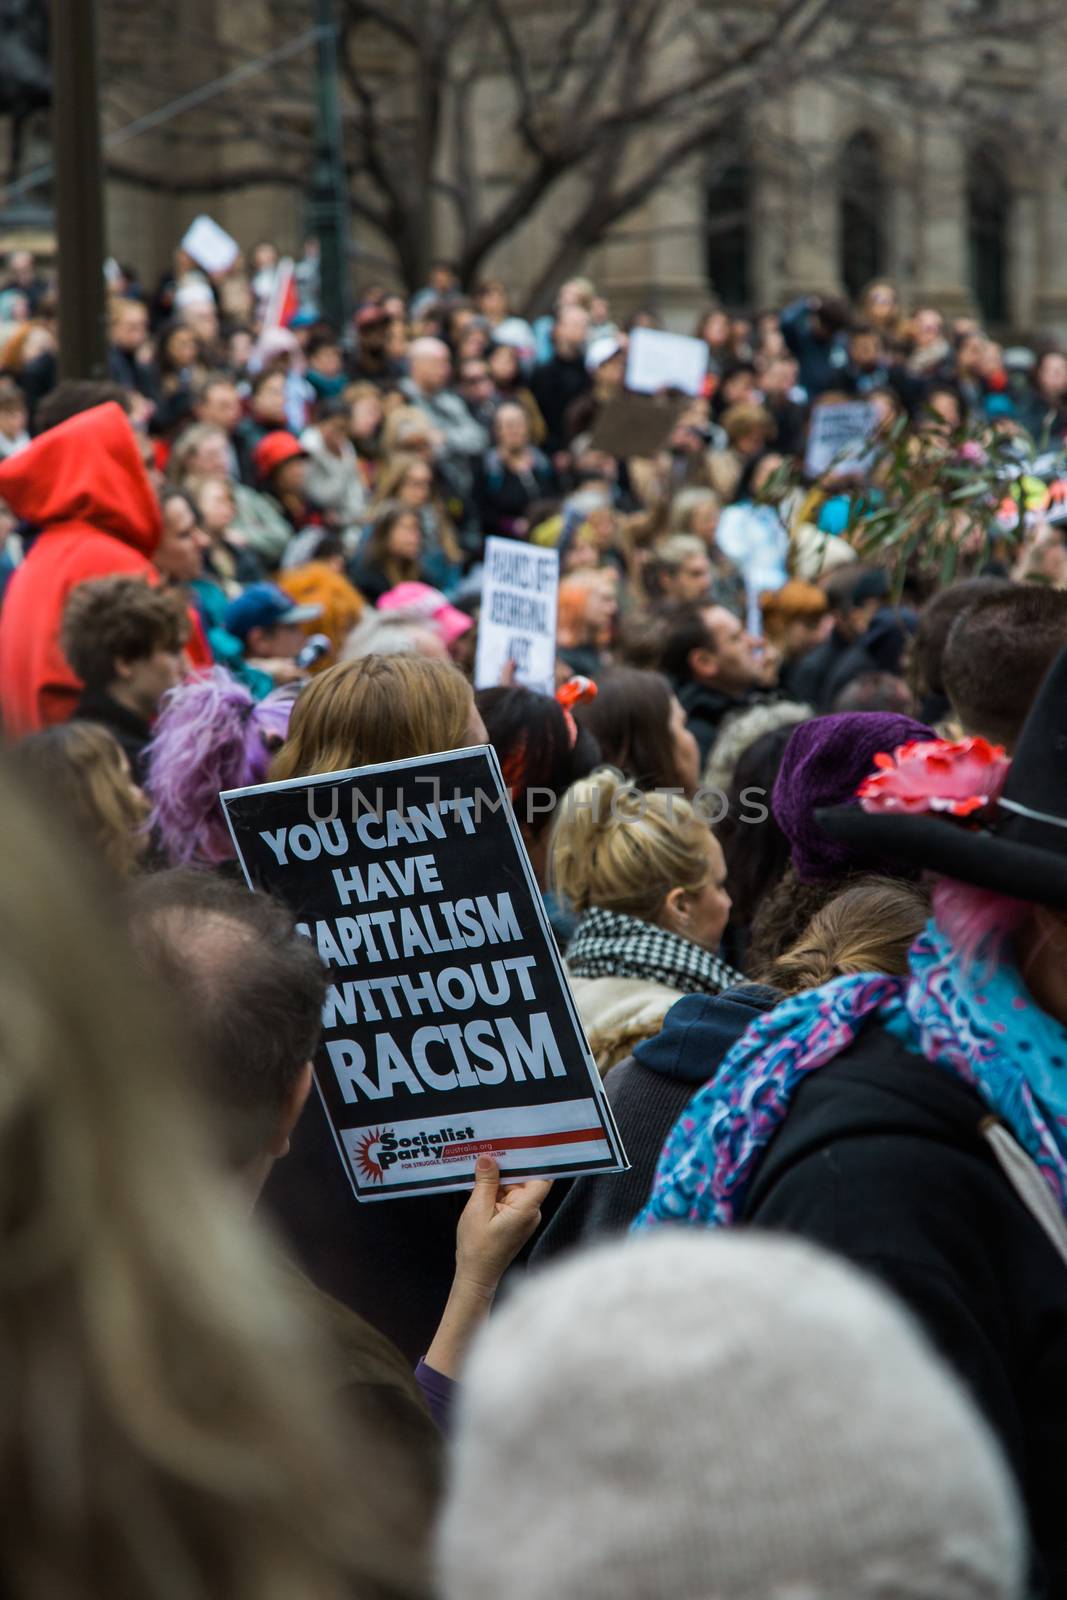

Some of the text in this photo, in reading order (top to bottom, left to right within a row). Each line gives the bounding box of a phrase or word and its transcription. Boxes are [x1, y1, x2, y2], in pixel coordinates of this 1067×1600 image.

[259, 797, 476, 866] YOU CAN'T
[332, 854, 444, 905] HAVE
[295, 892, 524, 968] APITALISM
[325, 1011, 568, 1104] RACISM
[379, 1127, 475, 1151] Socialist
